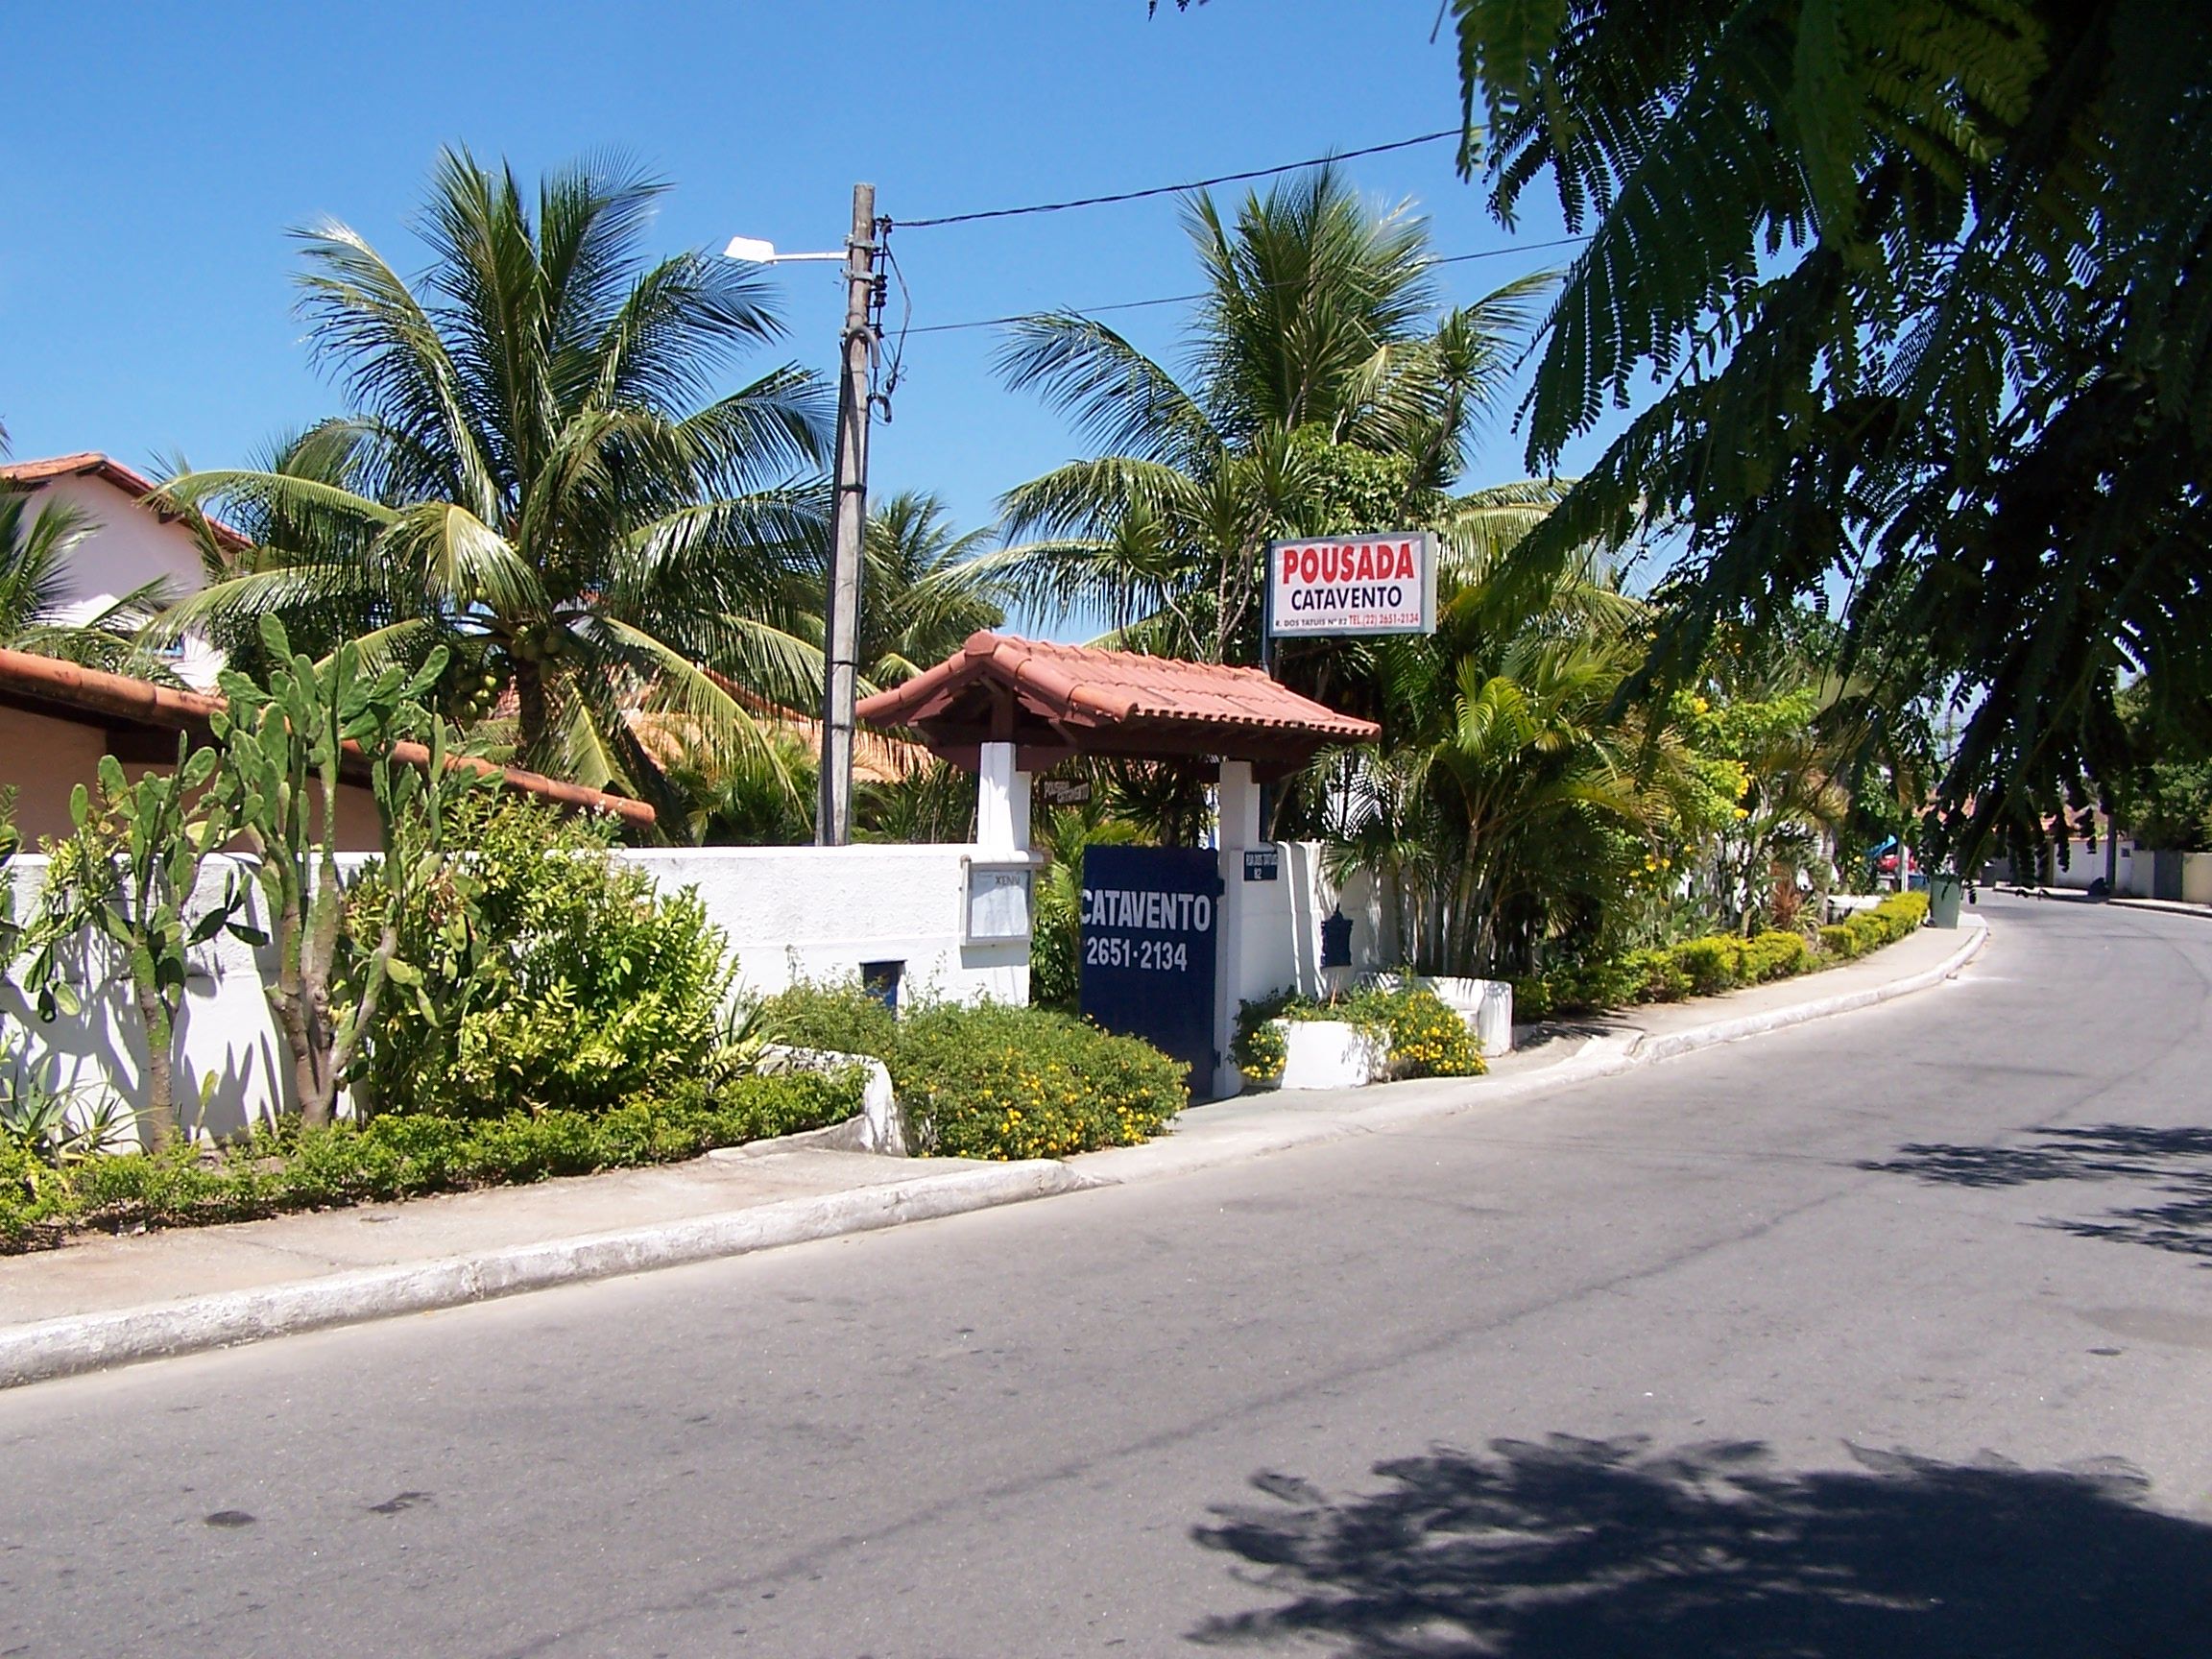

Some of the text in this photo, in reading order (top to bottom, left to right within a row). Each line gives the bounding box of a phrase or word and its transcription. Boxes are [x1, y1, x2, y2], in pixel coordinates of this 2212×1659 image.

[1283, 543, 1414, 584] POUSADA
[1291, 586, 1402, 611] CATAVENTO
[1284, 618, 1299, 627] DOS
[1379, 613, 1419, 625] 2651-2134
[1081, 888, 1211, 931] CATAVENTO
